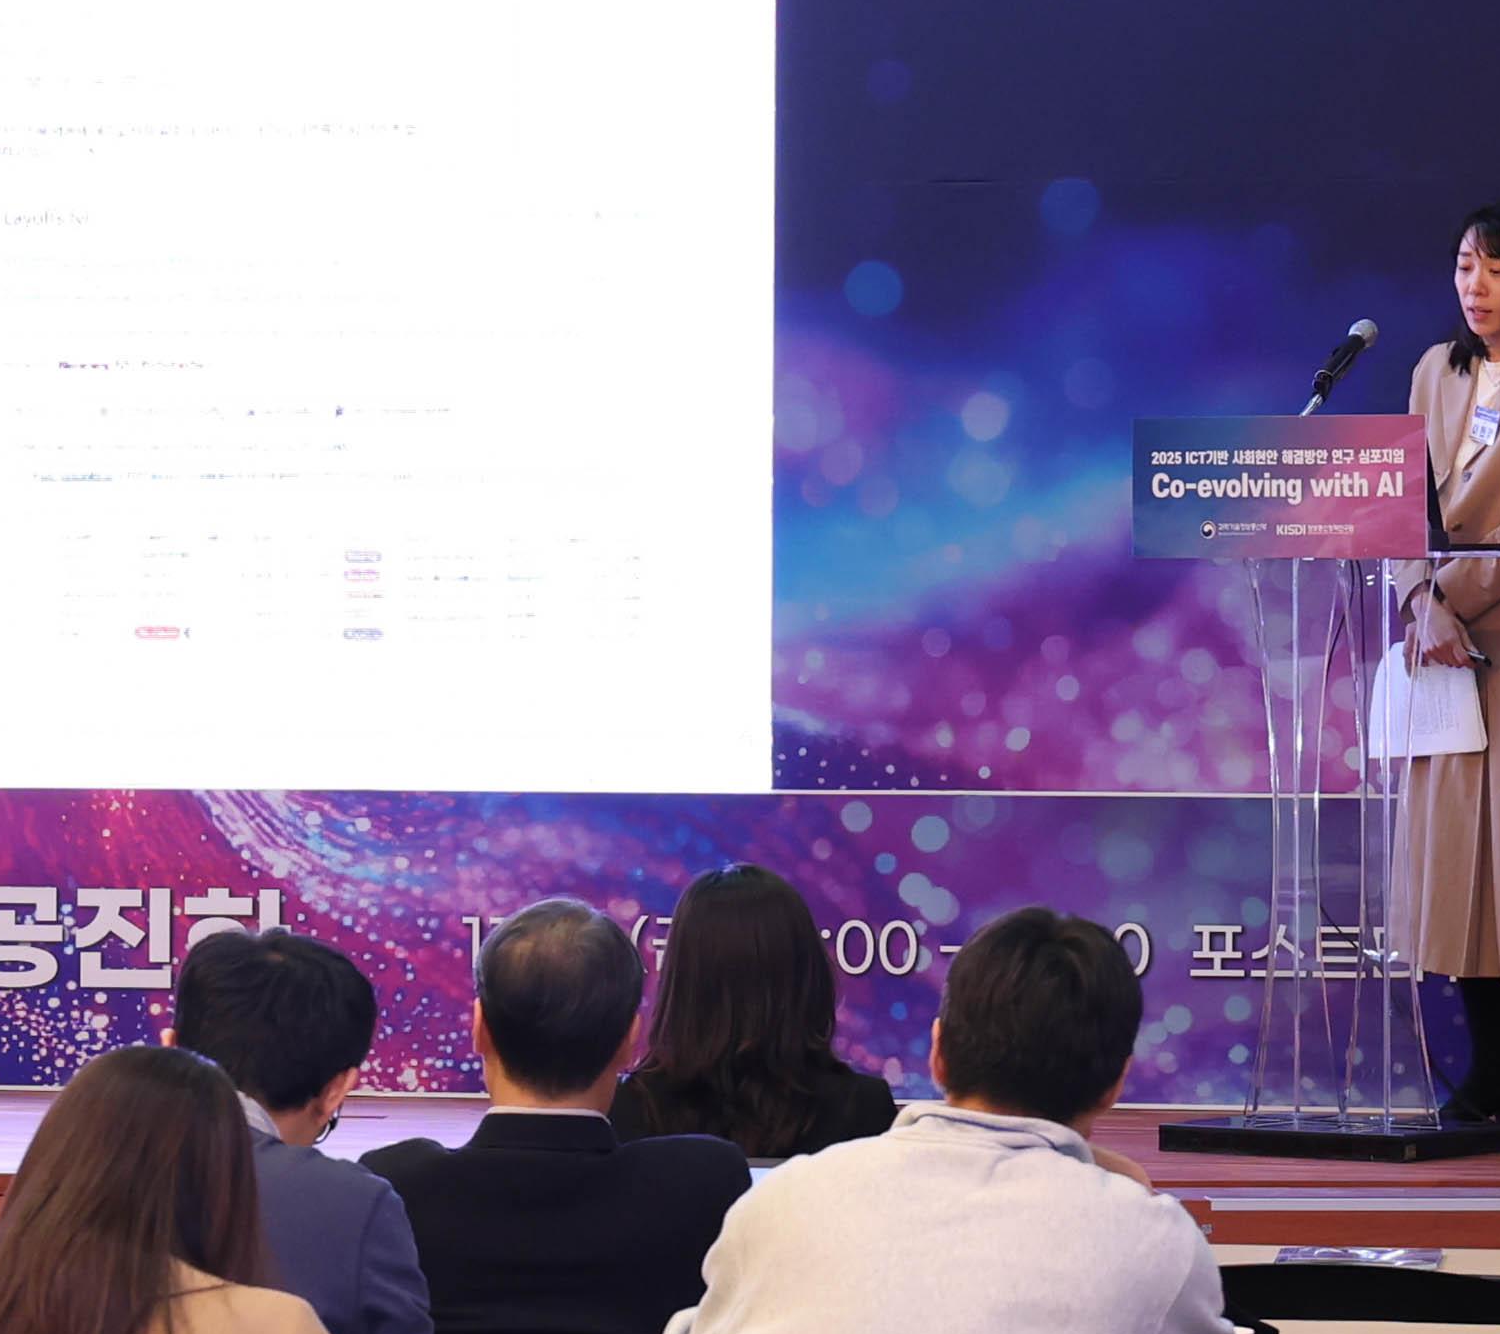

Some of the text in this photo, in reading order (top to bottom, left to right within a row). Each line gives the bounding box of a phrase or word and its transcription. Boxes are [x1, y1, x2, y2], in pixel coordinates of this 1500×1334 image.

[1151, 449, 1405, 465] 2025 ICT기반 사회현안 해결방안 연구 심포지엄
[1151, 470, 1403, 506] Co-evolving with AI
[1276, 524, 1306, 535] KISDI
